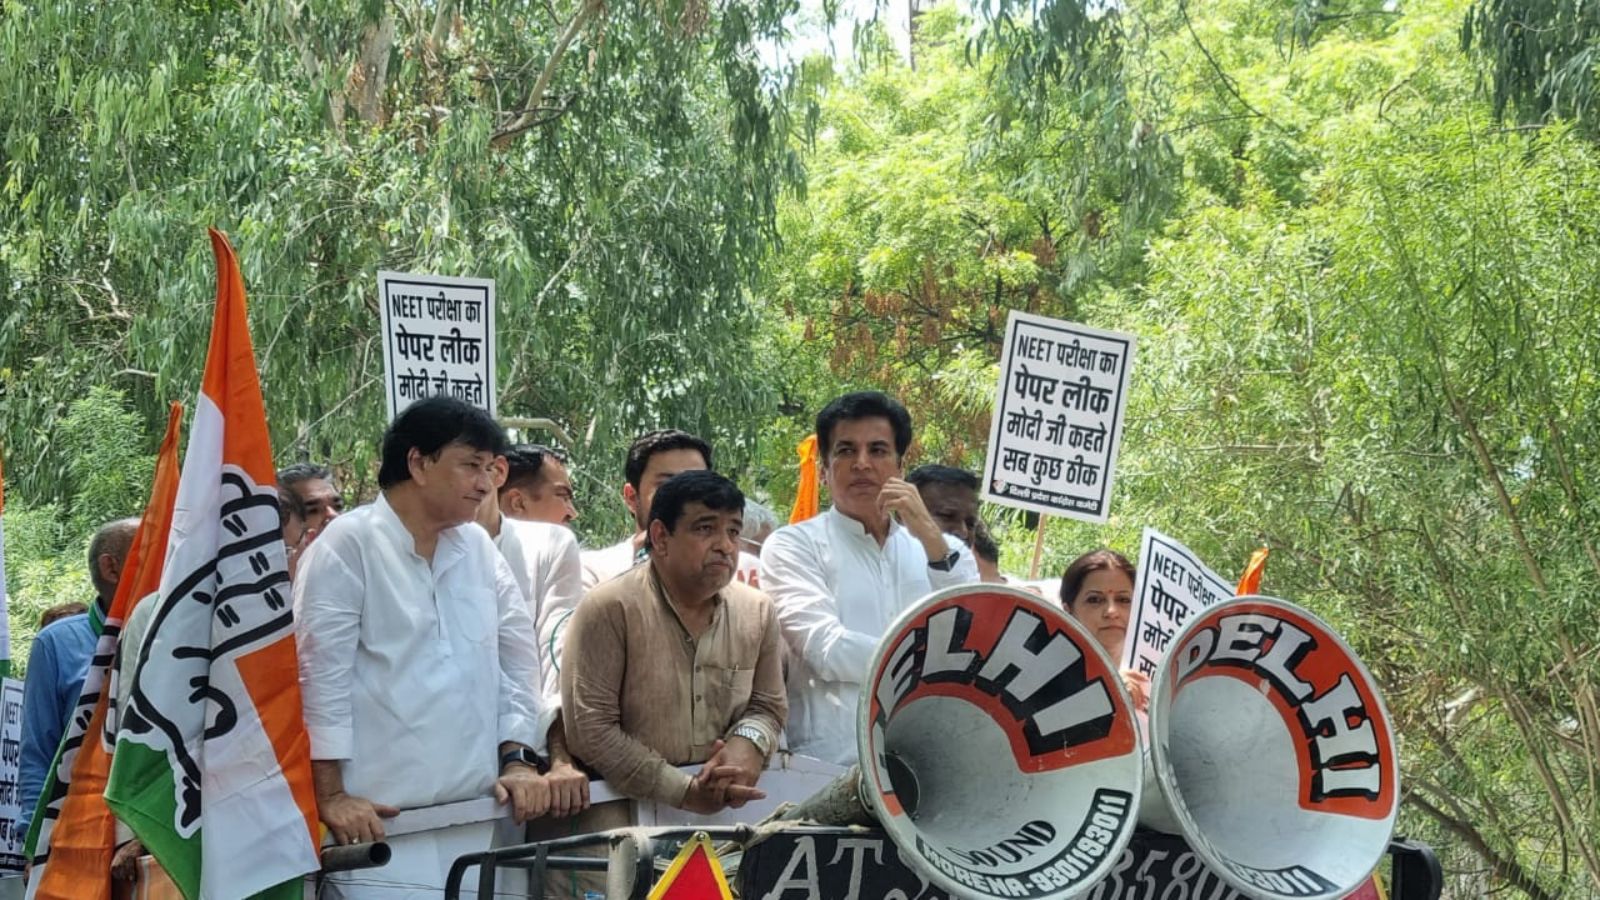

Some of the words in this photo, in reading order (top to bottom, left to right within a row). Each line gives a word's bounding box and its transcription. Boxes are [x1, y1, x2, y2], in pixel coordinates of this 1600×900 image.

[392, 294, 423, 319] NEET
[426, 291, 462, 322] परीक्षा
[464, 300, 482, 323] का
[395, 324, 435, 361] पेपर
[438, 327, 482, 365] लीक
[1017, 334, 1055, 363] NEET
[1056, 339, 1099, 371] परीक्षा
[1099, 350, 1119, 375] का
[397, 368, 430, 400] मोदी
[432, 370, 449, 398] जी
[450, 372, 483, 405] कहते
[1014, 363, 1059, 405] पेपर
[1061, 375, 1113, 415] लीक
[1006, 406, 1044, 441] मोदी
[1045, 414, 1067, 446] जी
[1068, 421, 1108, 454] कहते
[1002, 447, 1031, 473] सब
[1031, 453, 1064, 486] कुछ
[1065, 454, 1100, 487] ठीक
[1153, 552, 1186, 586] NEET
[1187, 571, 1217, 607] परीक्षा
[1151, 579, 1188, 627] पेपर
[1139, 654, 1157, 682] स
[1176, 612, 1382, 803] DELHI
[946, 820, 1058, 868] SOUND
